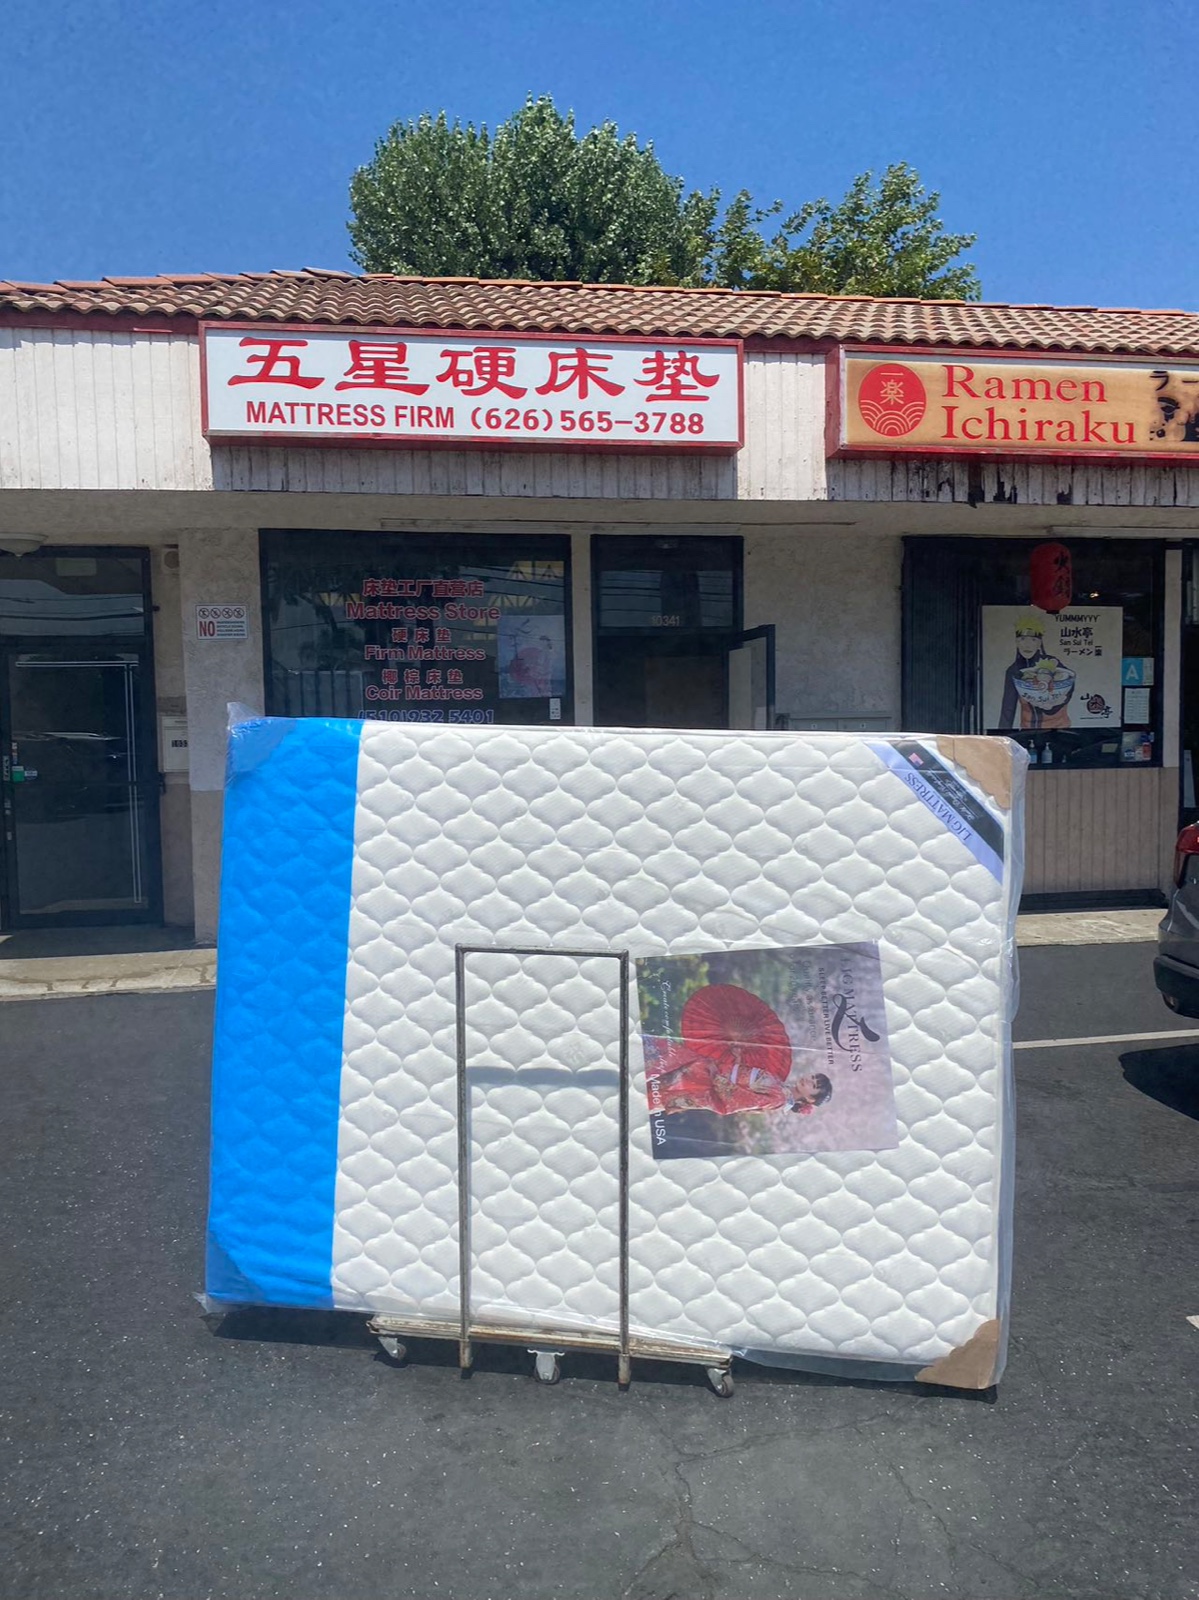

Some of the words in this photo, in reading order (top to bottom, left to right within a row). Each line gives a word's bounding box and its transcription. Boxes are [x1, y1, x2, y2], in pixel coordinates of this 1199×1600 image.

[227, 336, 720, 402] 五星硬床垫
[941, 365, 1108, 403] Ramen
[246, 400, 386, 427] MATTRESS
[395, 405, 455, 428] FIRM
[941, 405, 1137, 444] Ichiraku
[363, 578, 484, 598] 床垫工厂直营店
[346, 603, 439, 620] Mattress
[444, 603, 500, 620] Store
[198, 620, 216, 638] NO
[392, 627, 452, 643] 硬床垫
[365, 645, 404, 661] Firm
[407, 645, 487, 661] Mattress
[1125, 664, 1140, 681] A
[365, 685, 402, 701] Coir
[405, 685, 484, 701] Mattress
[448, 709, 495, 724] 5401
[904, 771, 956, 824] MATTRESS
[951, 819, 972, 842] LIG
[818, 968, 826, 989] SLEEP
[826, 1038, 834, 1065] BETTER
[844, 988, 862, 1072] MATTRESS
[650, 1073, 662, 1104] Made
[655, 1119, 667, 1145] USA
